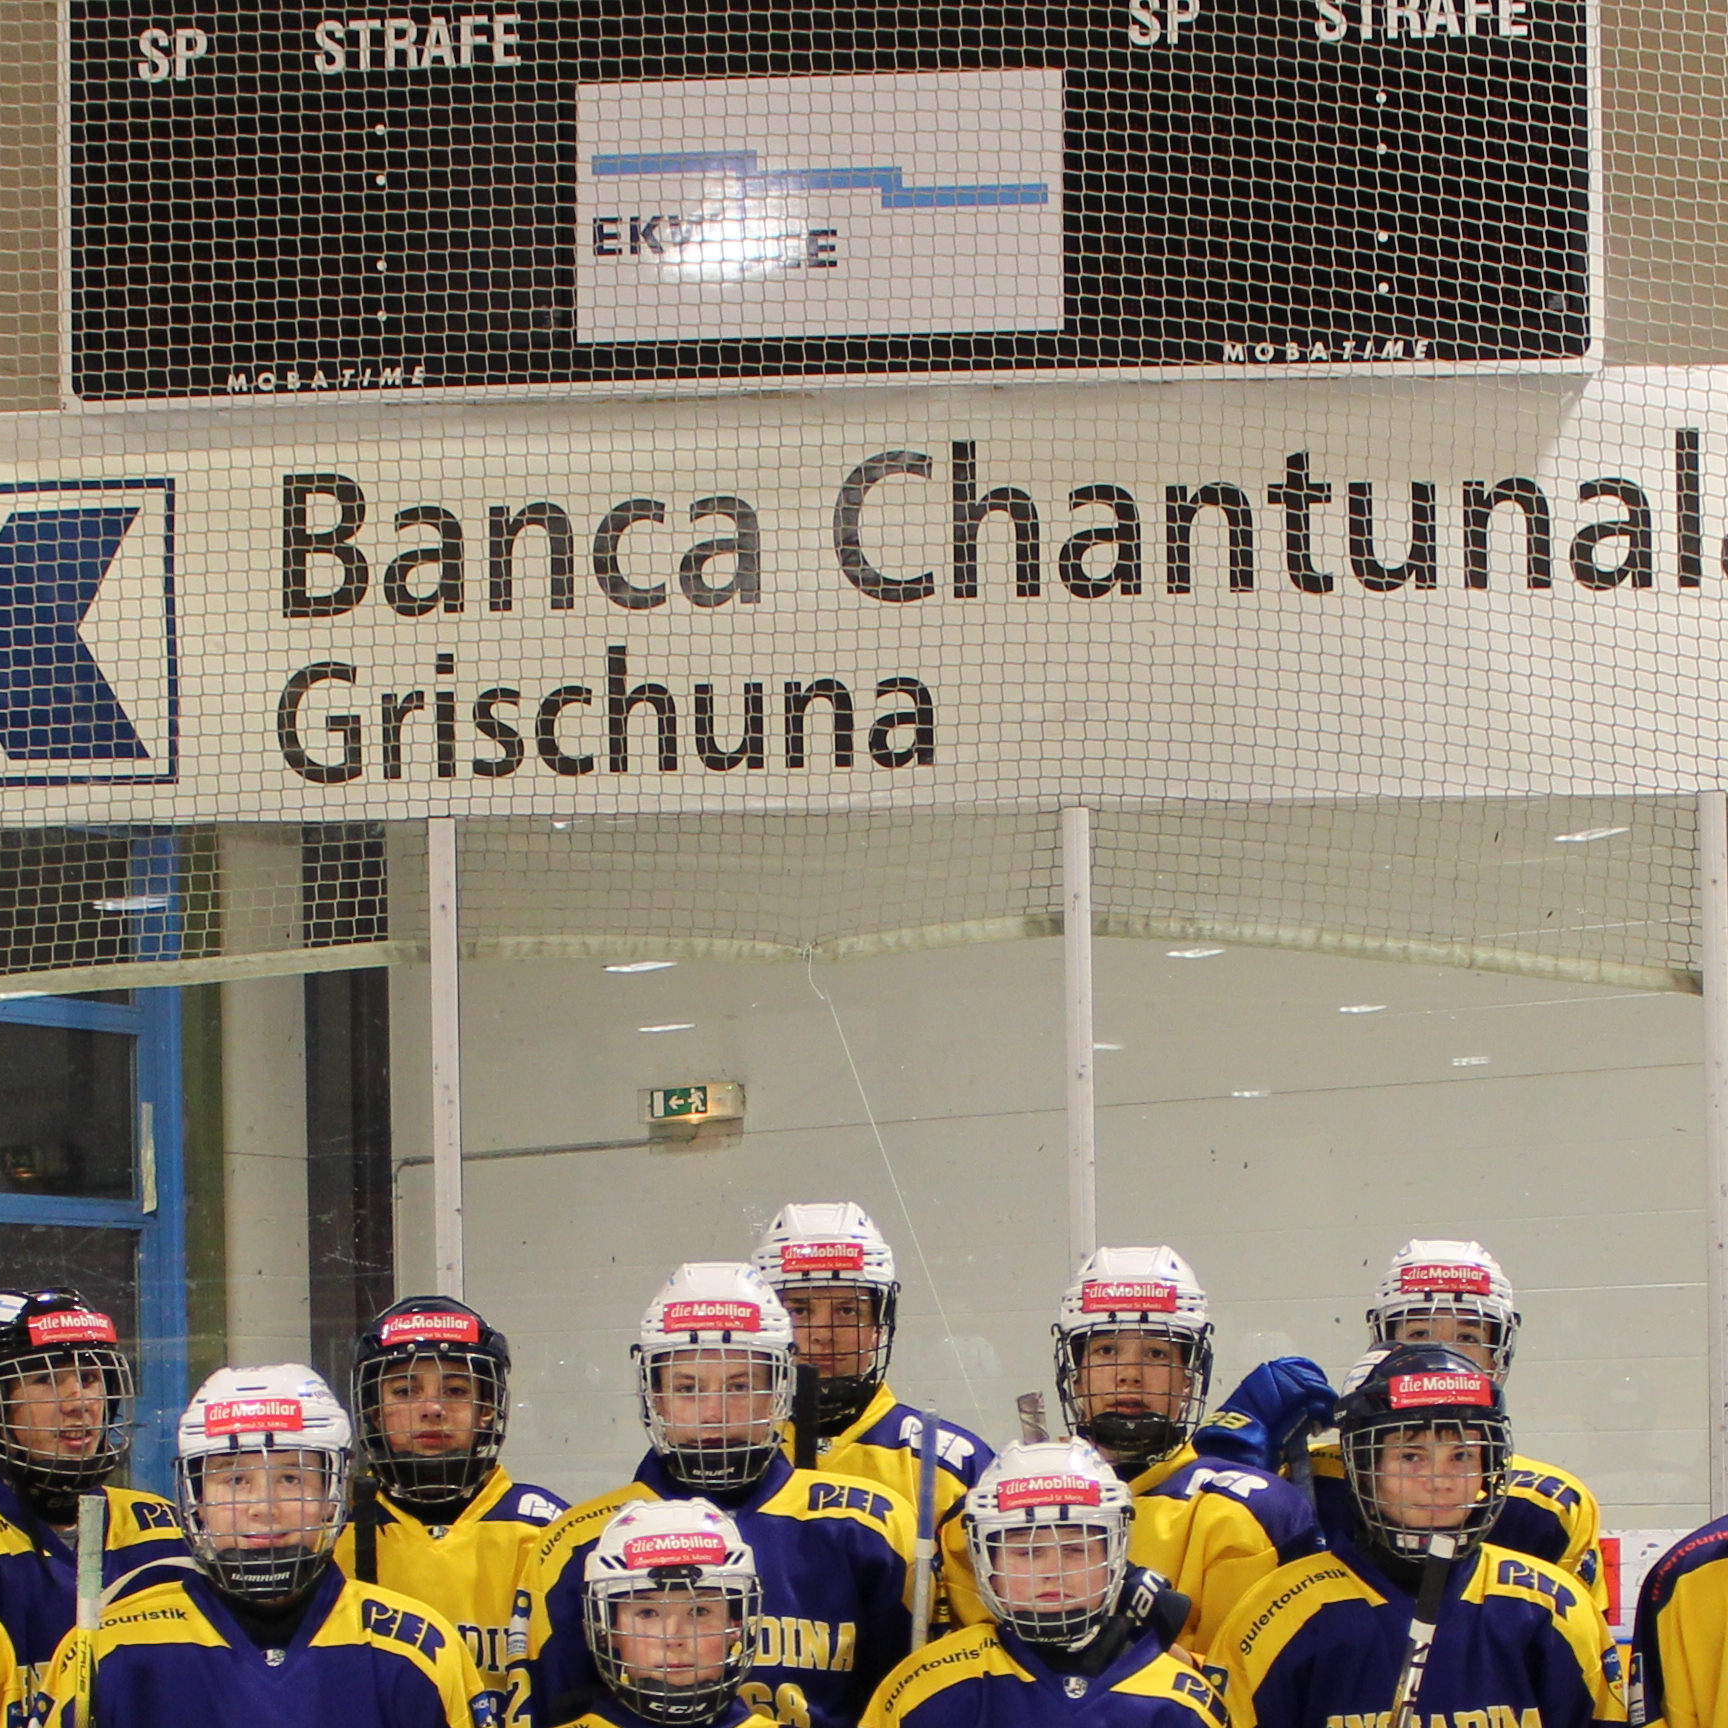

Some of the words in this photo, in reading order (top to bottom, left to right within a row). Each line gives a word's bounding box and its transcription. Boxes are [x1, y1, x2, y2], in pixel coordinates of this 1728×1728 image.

[137, 28, 208, 83] SP
[314, 14, 522, 76] STRAFE
[281, 472, 762, 620] Banca
[276, 646, 937, 785] Grischuna
[1429, 1266, 1485, 1281] Mobiliar
[693, 1303, 754, 1319] Mobiliar
[1423, 1376, 1482, 1392] Mobiliar
[1029, 1476, 1091, 1492] Mobiliar
[1239, 1565, 1349, 1656] gulertouristik
